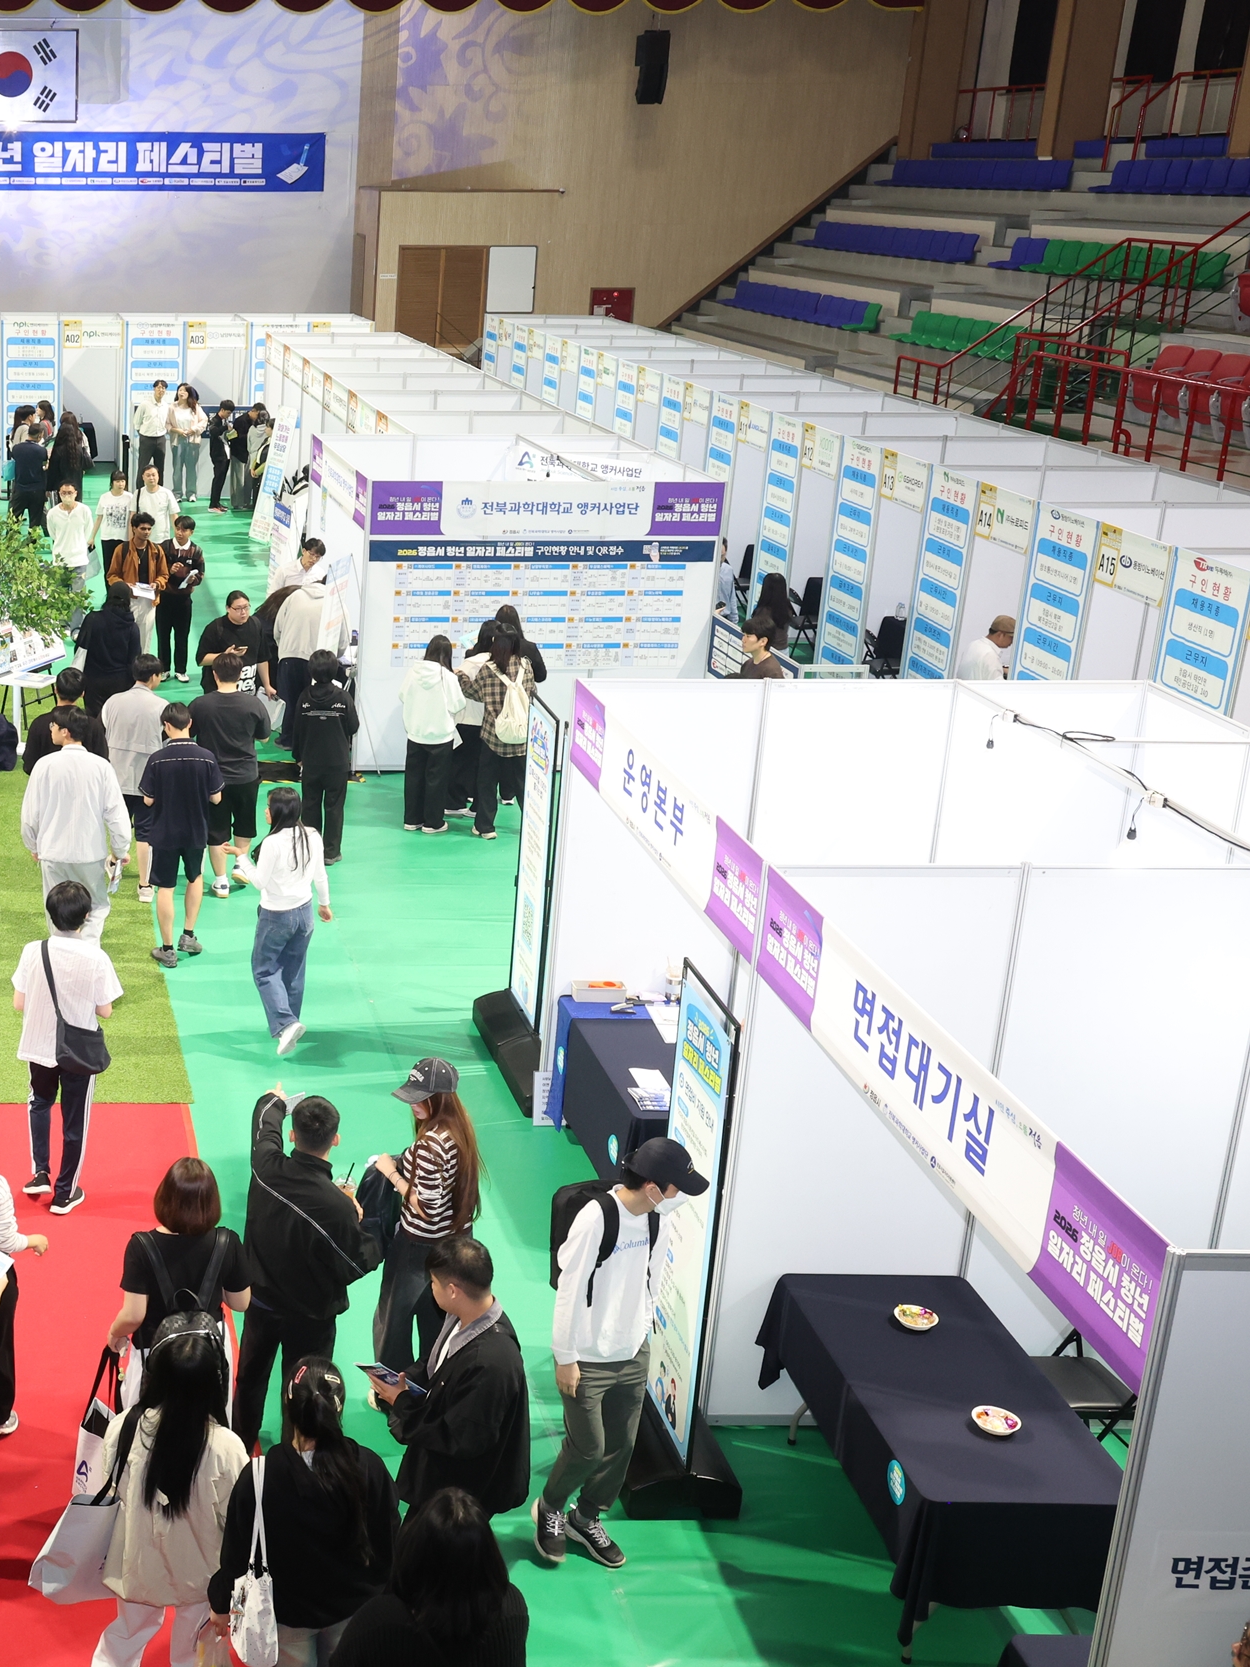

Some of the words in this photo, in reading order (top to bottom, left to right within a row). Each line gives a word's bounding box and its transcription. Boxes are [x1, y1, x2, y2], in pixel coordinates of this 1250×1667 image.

[32, 141, 127, 173] 일자리
[136, 141, 263, 174] 페스티벌
[65, 334, 80, 343] A02
[190, 335, 204, 344] A03
[601, 464, 642, 479] 앵커사업단
[850, 454, 872, 470] 구인현황
[883, 474, 894, 490] A13
[940, 485, 966, 505] 구인현황
[396, 502, 421, 511] 정읍시
[423, 502, 439, 511] 청년
[481, 502, 573, 516] 전북과학대학교
[577, 502, 639, 516] 앵커사업단
[674, 503, 698, 512] 정읍시
[700, 503, 717, 512] 청년
[377, 512, 402, 521] 일자리
[404, 512, 439, 521] 페스티벌
[655, 513, 680, 522] 일자리
[682, 513, 716, 522] 페스티벌
[978, 510, 992, 529] A14
[1049, 525, 1082, 548] 구인현황
[418, 546, 445, 557] 정읍시
[446, 546, 465, 557] 청년
[466, 546, 494, 557] 일자리
[495, 546, 533, 557] 페스티벌
[535, 545, 568, 556] 구인현황
[569, 545, 585, 556] 안내
[586, 545, 595, 556] 및
[596, 545, 624, 556] QR접수
[1052, 545, 1074, 562] 채용직종
[1098, 553, 1116, 576] A15
[1189, 574, 1232, 602] 구인현황
[1046, 591, 1063, 606] 근무지
[1191, 597, 1221, 617] 채용직종
[1188, 621, 1202, 635] 생산직
[1036, 634, 1058, 652] 근무시간
[1185, 649, 1208, 668] 근무지
[623, 748, 685, 847] 운영본부
[716, 862, 728, 880] 2026
[713, 876, 730, 908] 일자리
[730, 894, 756, 935] 페스티벌
[770, 918, 783, 938] 2026
[782, 927, 804, 962] 정읍시
[803, 948, 819, 978] 청년
[766, 933, 788, 968] 일자리
[786, 952, 816, 999] 페스티벌
[686, 1019, 705, 1056] 정읍시
[705, 1039, 720, 1071] 청년
[853, 979, 995, 1178] 면접대기실
[1072, 1205, 1088, 1229] 청년
[1088, 1221, 1097, 1238] 내
[1098, 1230, 1107, 1248] 일
[1053, 1209, 1079, 1243] 2026
[1080, 1230, 1120, 1289] 정읍시
[1120, 1272, 1150, 1320] 청년
[1047, 1229, 1088, 1287] 일자리
[1087, 1270, 1145, 1348] 페스티벌
